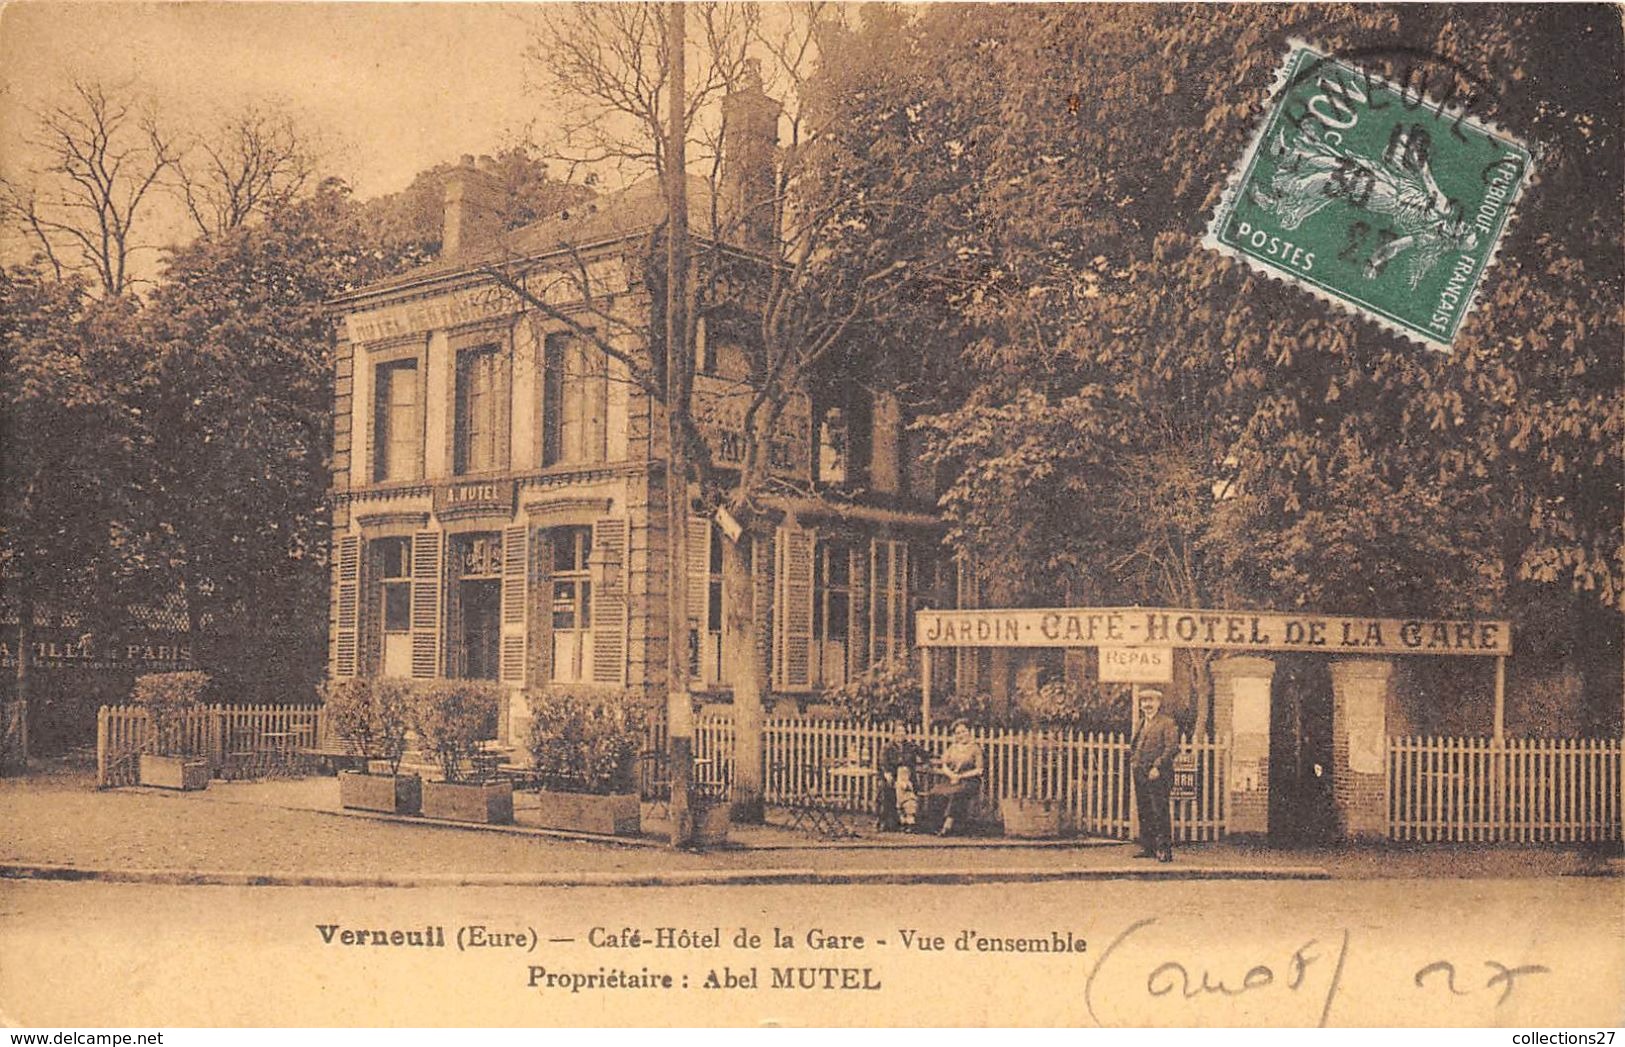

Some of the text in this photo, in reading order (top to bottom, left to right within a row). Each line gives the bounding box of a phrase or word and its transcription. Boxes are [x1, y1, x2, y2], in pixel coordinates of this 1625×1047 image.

[1238, 222, 1316, 272] POSTES
[1430, 254, 1477, 334] FRANÇAISE
[927, 617, 1019, 641] JARDIN
[1145, 614, 1270, 645] HOTEL
[1284, 620, 1327, 646] DE
[1340, 621, 1386, 647] LA
[1400, 620, 1500, 650] GARE
[128, 645, 192, 660] PARIS
[1106, 650, 1161, 665] REPAS
